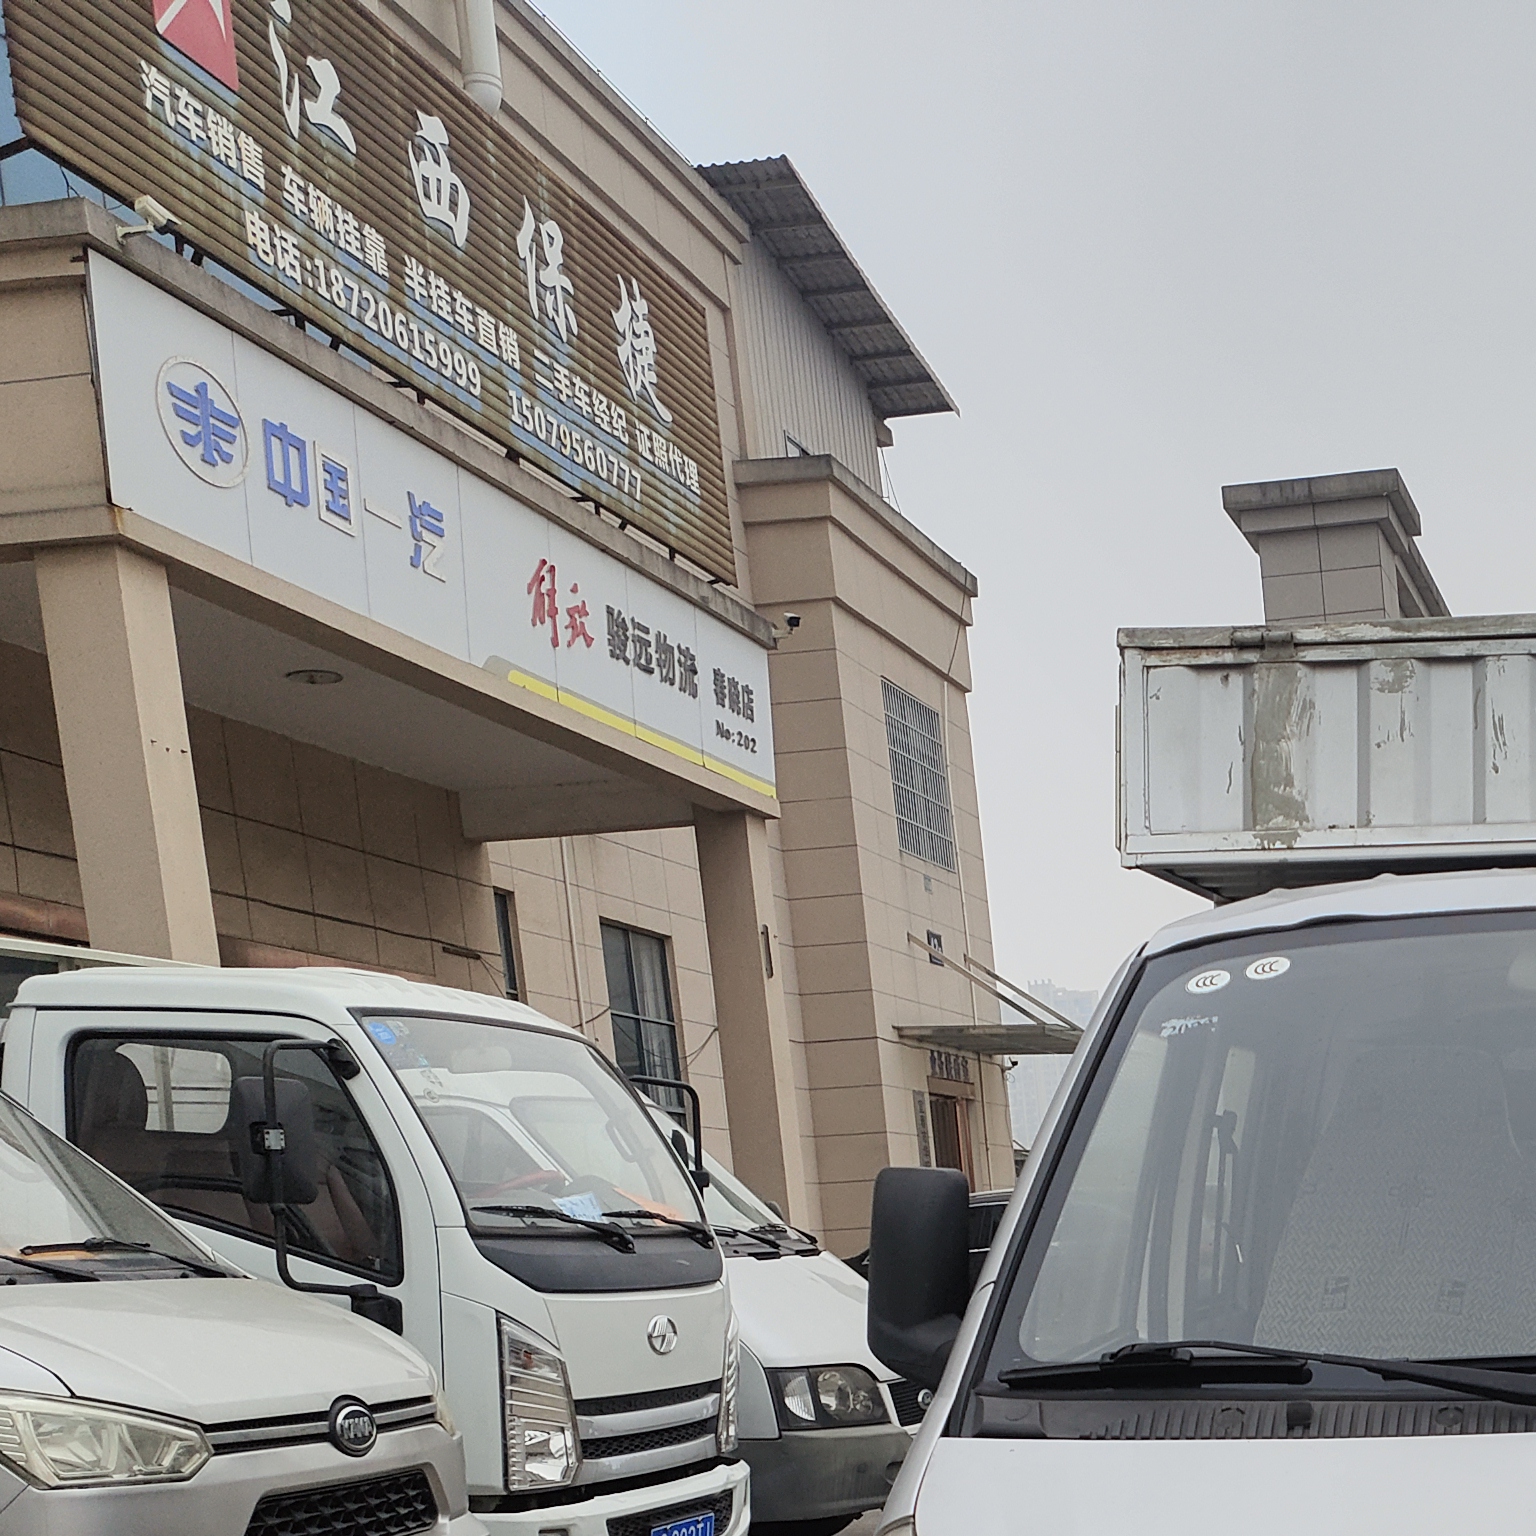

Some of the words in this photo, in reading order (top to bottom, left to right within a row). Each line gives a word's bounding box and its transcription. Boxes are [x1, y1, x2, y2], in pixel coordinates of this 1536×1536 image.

[139, 59, 266, 191] 汽车销售
[281, 164, 389, 281] 车辆挂靠
[404, 254, 521, 371] 半挂车直销
[533, 348, 629, 445] 二手车经纪
[634, 420, 701, 496] 证照代理
[268, 0, 673, 423] 江西保捷
[262, 417, 447, 583] 中国一汽
[527, 558, 595, 648] 解放
[605, 604, 699, 699] 骏远物流
[508, 389, 642, 501] 15079560777
[715, 719, 758, 753] No:202
